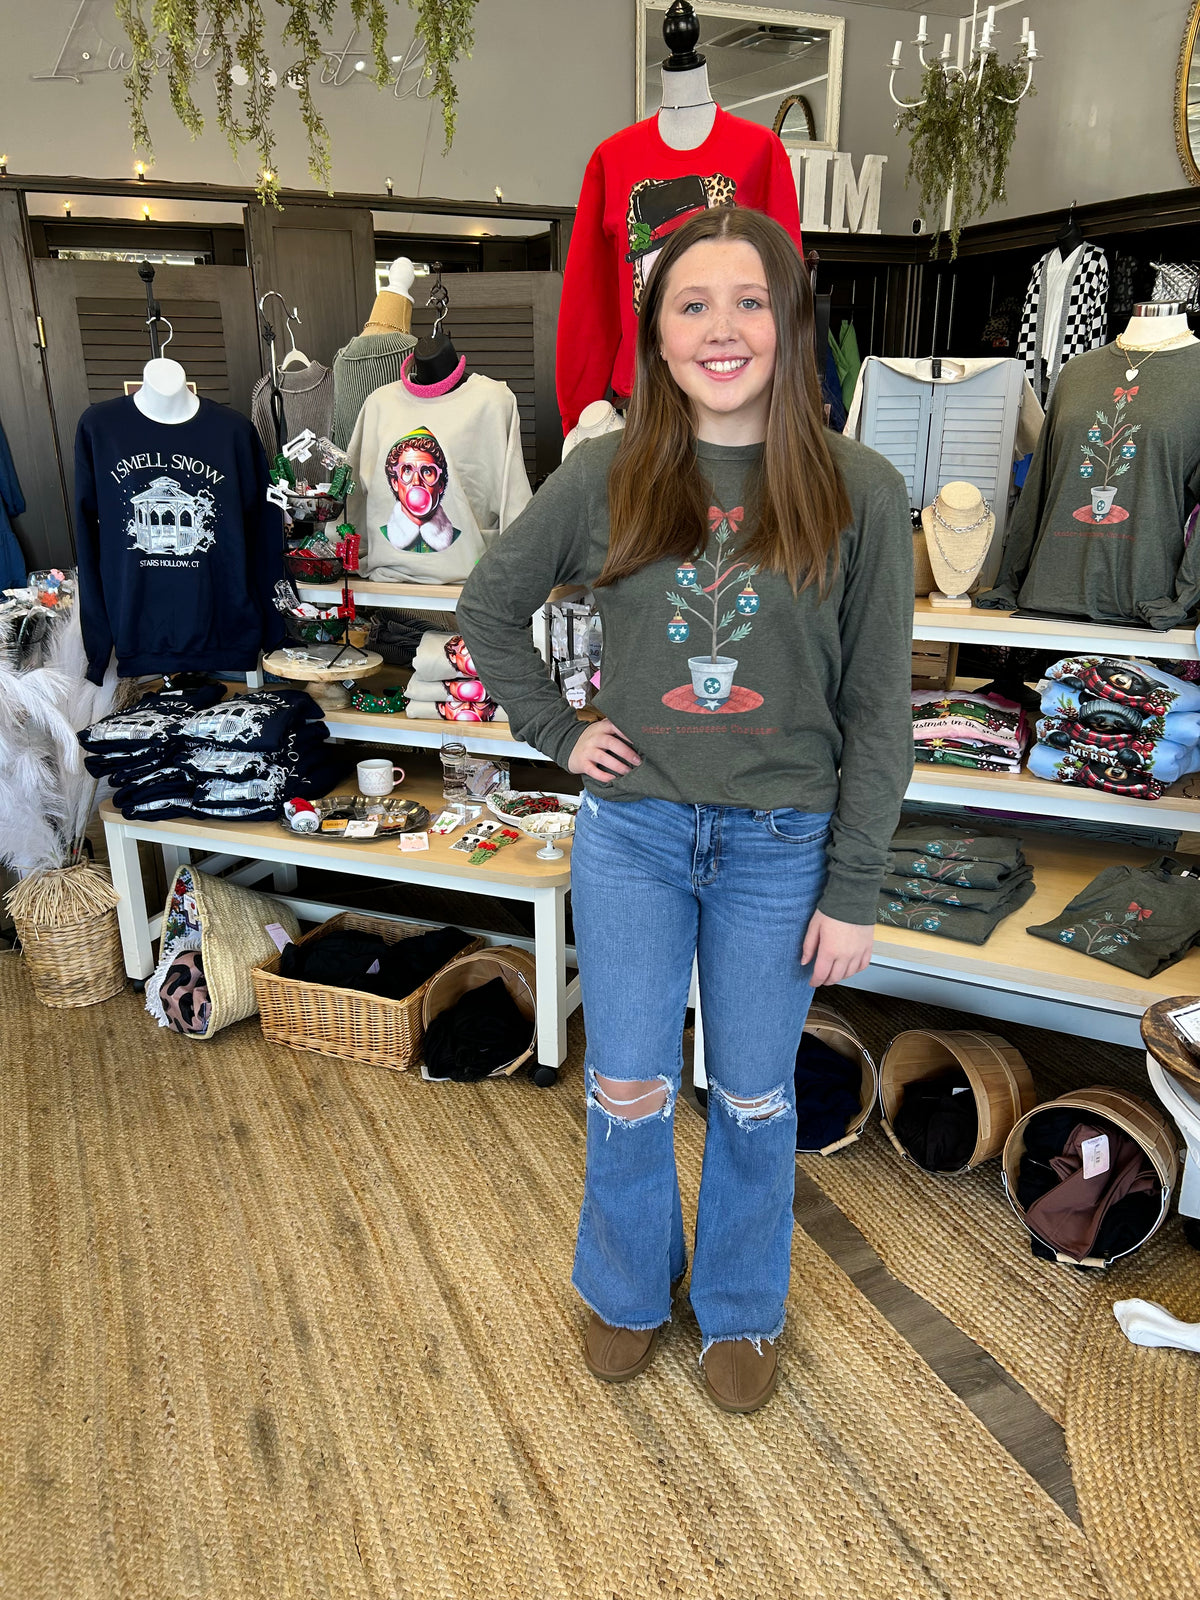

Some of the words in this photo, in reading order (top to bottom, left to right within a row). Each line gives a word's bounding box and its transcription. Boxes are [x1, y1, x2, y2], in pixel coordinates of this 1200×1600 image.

[110, 470, 121, 484] I
[116, 452, 168, 479] SMELL
[171, 453, 225, 484] SNOW
[139, 559, 160, 568] STARS
[191, 560, 200, 568] CT
[1068, 745, 1119, 767] MERRY
